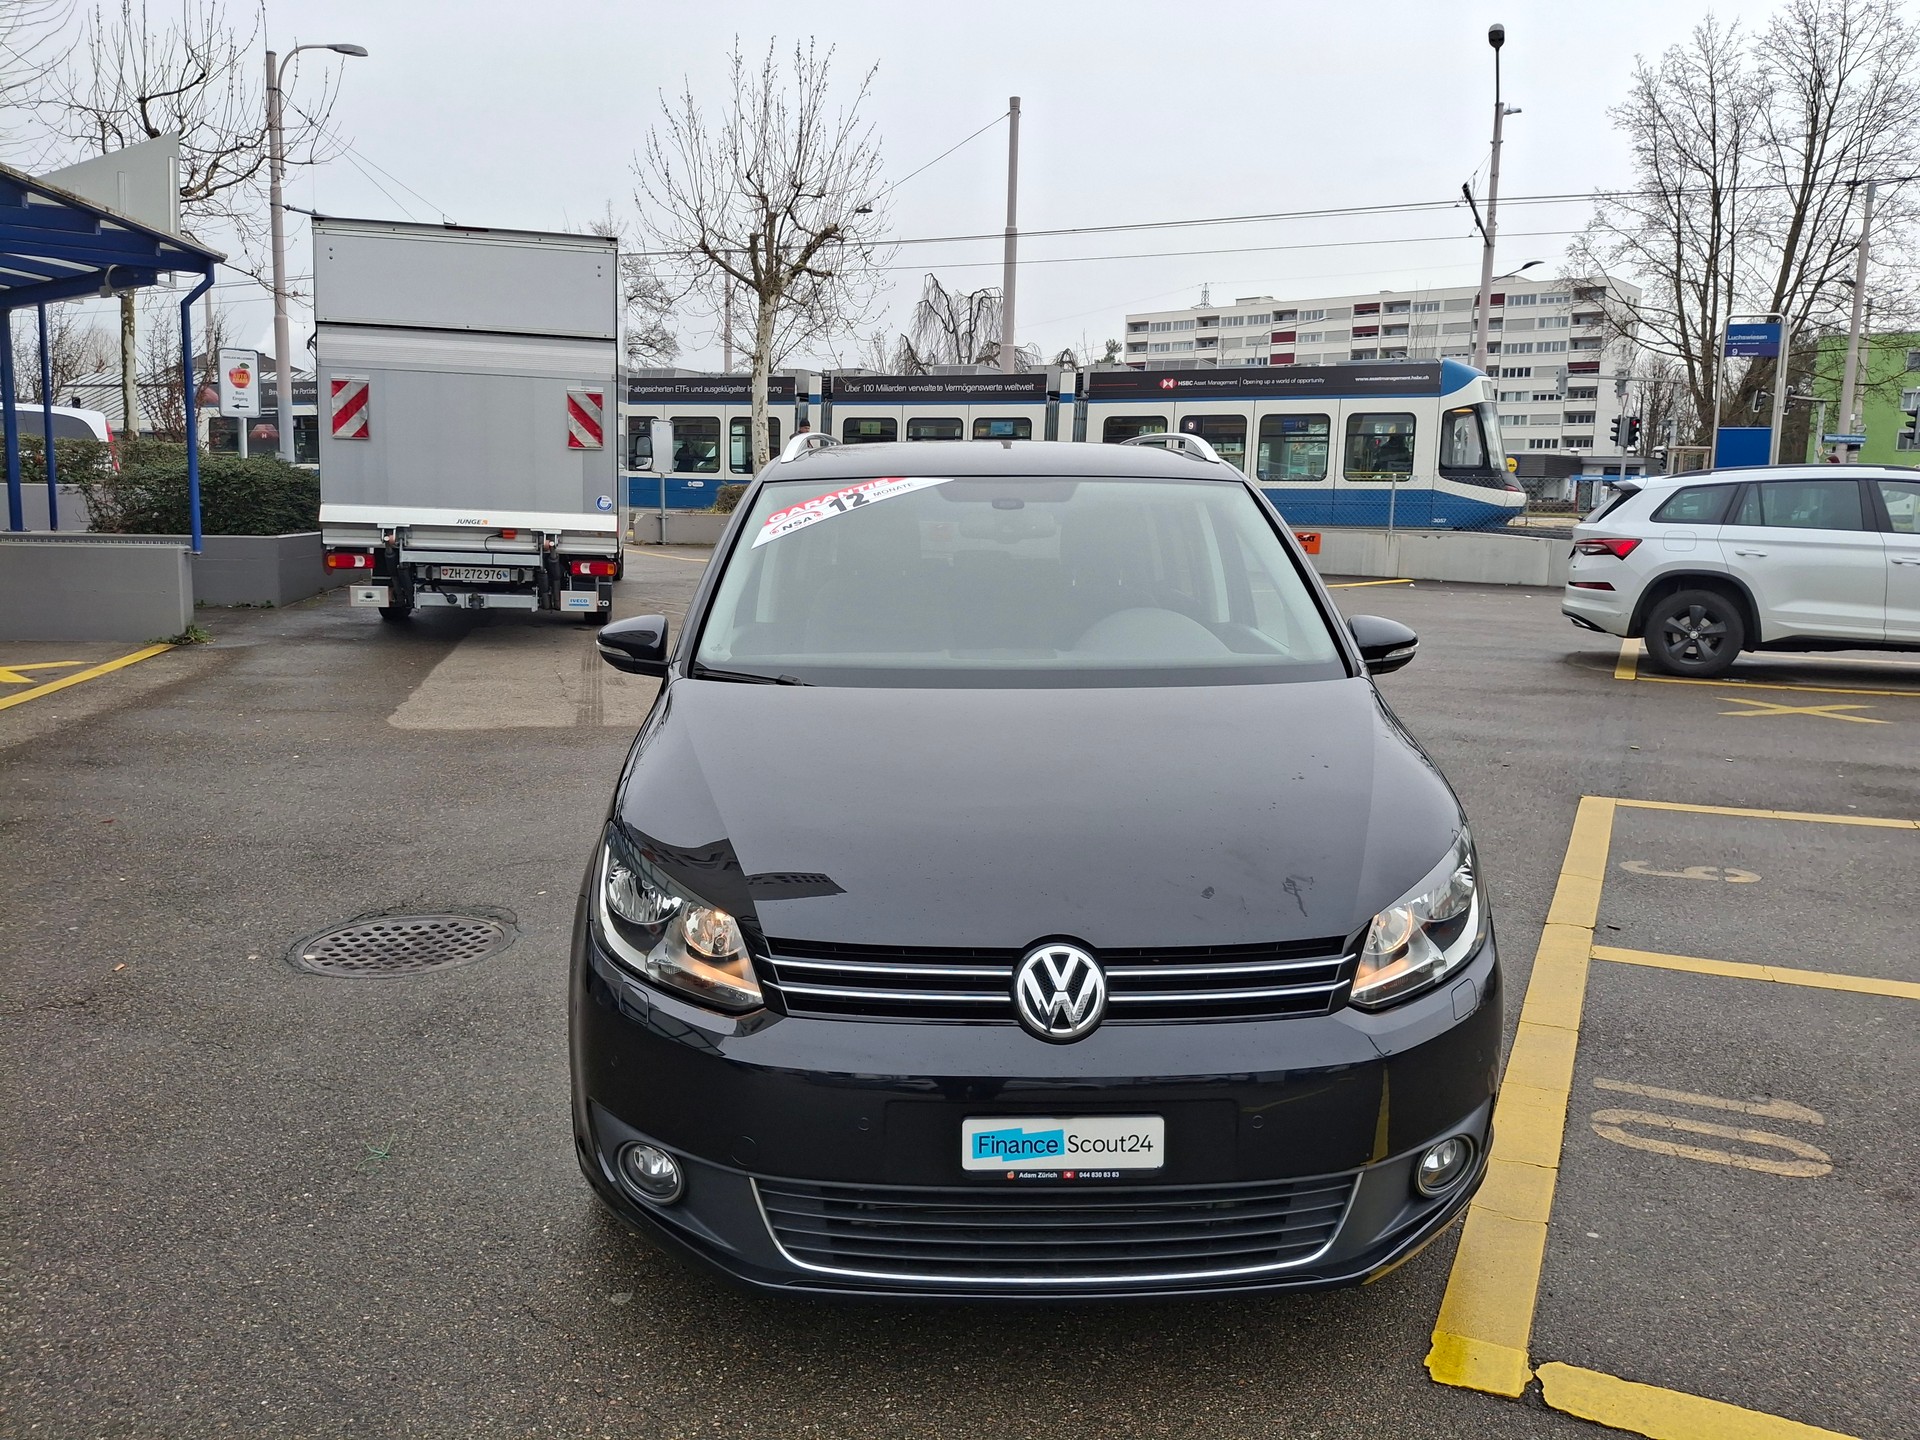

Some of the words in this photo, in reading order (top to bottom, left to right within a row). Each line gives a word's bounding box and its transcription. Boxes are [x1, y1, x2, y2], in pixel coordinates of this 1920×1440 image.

[1731, 348, 1738, 356] 9
[1208, 379, 1238, 387] Management
[1242, 378, 1263, 387] Opening
[1297, 377, 1326, 386] opportunity
[629, 384, 674, 395] F-abgesicherten
[675, 384, 690, 393] ETFs
[690, 384, 703, 393] und
[703, 384, 746, 395] ausgeklügelter
[845, 384, 861, 393] Über
[862, 383, 875, 393] 100
[875, 383, 907, 393] Milliarden
[944, 383, 1003, 394] Vermögenswerte
[1004, 382, 1034, 392] weltweit
[1187, 421, 1194, 430] 9
[769, 478, 891, 524] GARANTIE
[828, 492, 870, 513] 12
[873, 482, 913, 497] MONATE
[782, 516, 813, 531] NSA
[1018, 1171, 1037, 1179] Adam
[1037, 1171, 1058, 1179] Zürich
